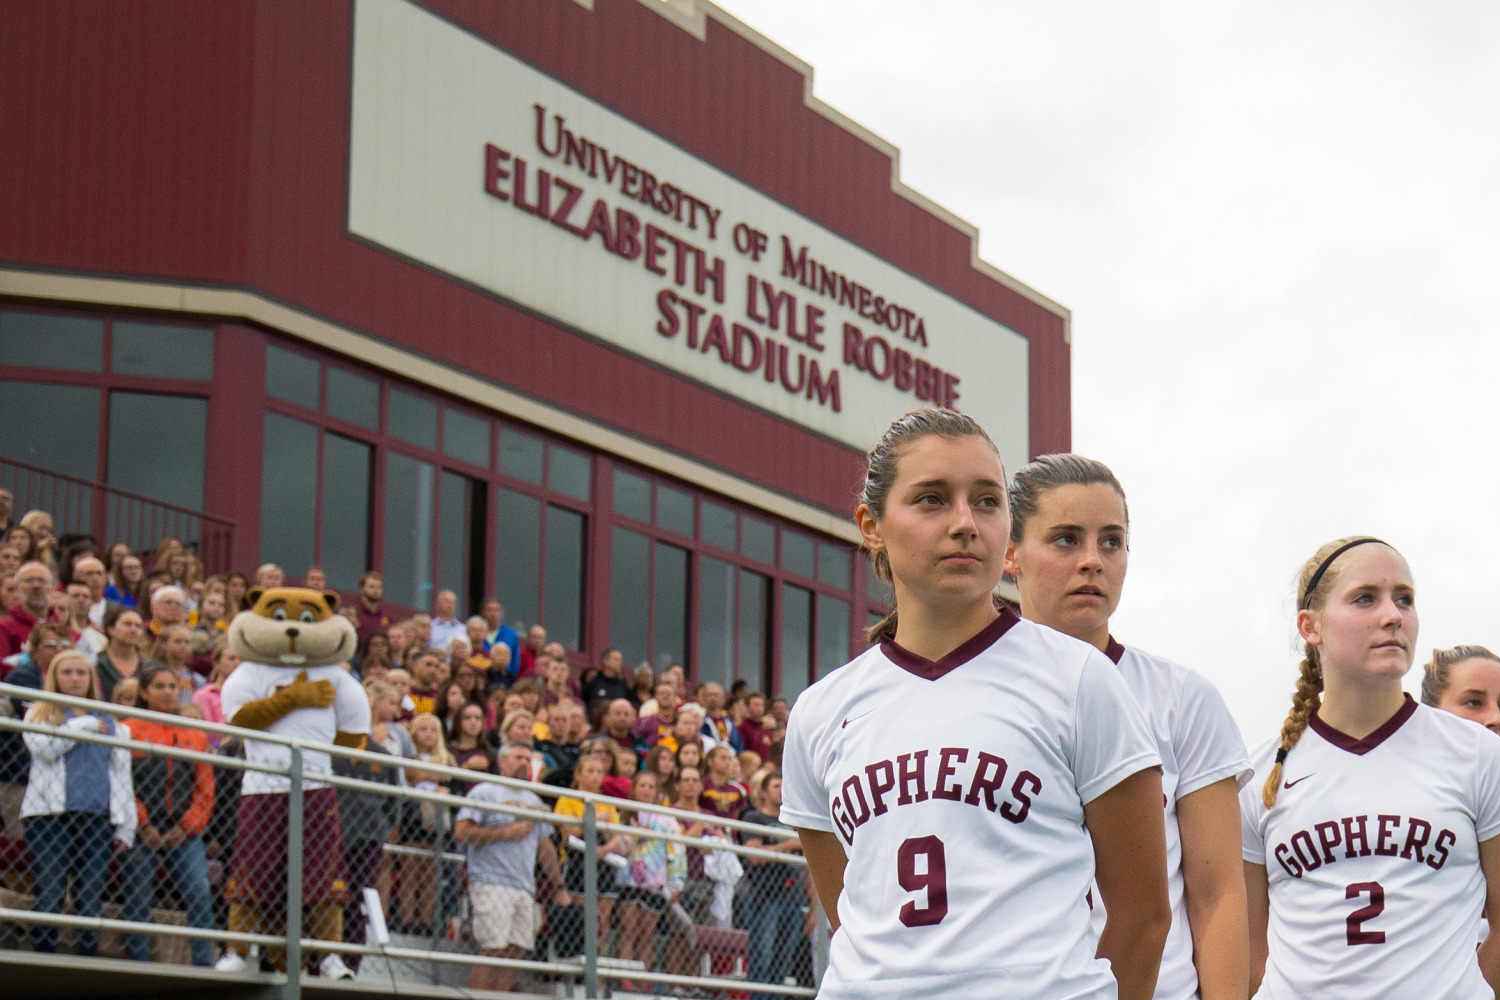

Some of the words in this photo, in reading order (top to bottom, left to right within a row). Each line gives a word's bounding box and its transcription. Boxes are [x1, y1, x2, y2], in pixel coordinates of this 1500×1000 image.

[533, 104, 722, 240] UNIVERSITY
[733, 222, 768, 262] OF
[780, 235, 929, 348] MINNESOTA
[483, 142, 725, 304] ELIZABETH
[746, 274, 826, 352] LYLE
[842, 321, 961, 411] ROBBIE
[656, 288, 842, 412] STADIUM
[831, 747, 1043, 847] GOPHERS
[1274, 814, 1457, 879] GOPHERS
[897, 834, 949, 928] 9
[1345, 880, 1386, 947] 2
